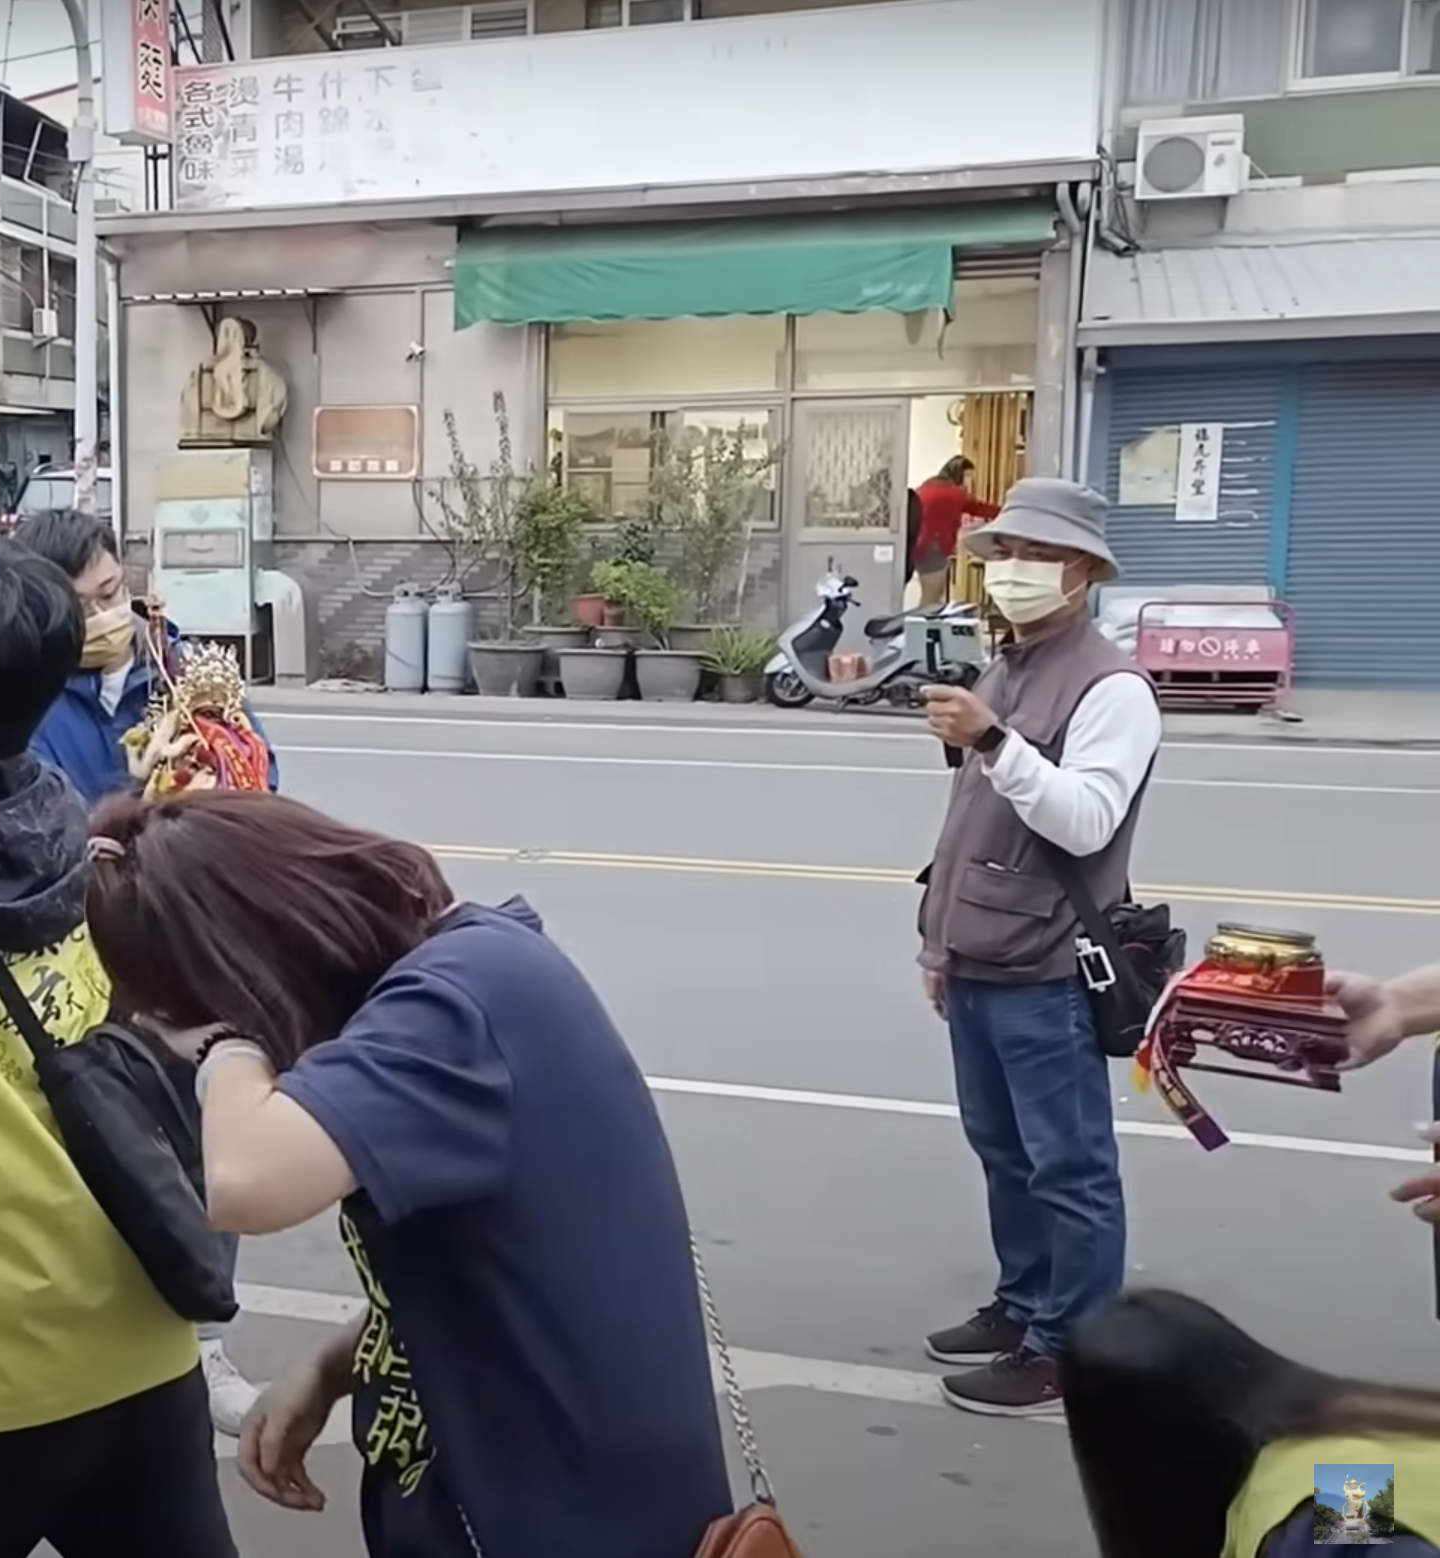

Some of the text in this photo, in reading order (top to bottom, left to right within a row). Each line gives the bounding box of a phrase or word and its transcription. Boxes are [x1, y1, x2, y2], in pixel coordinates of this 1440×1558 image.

[273, 73, 305, 176] 牛肉湯
[1159, 637, 1261, 655] 請勿 停車
